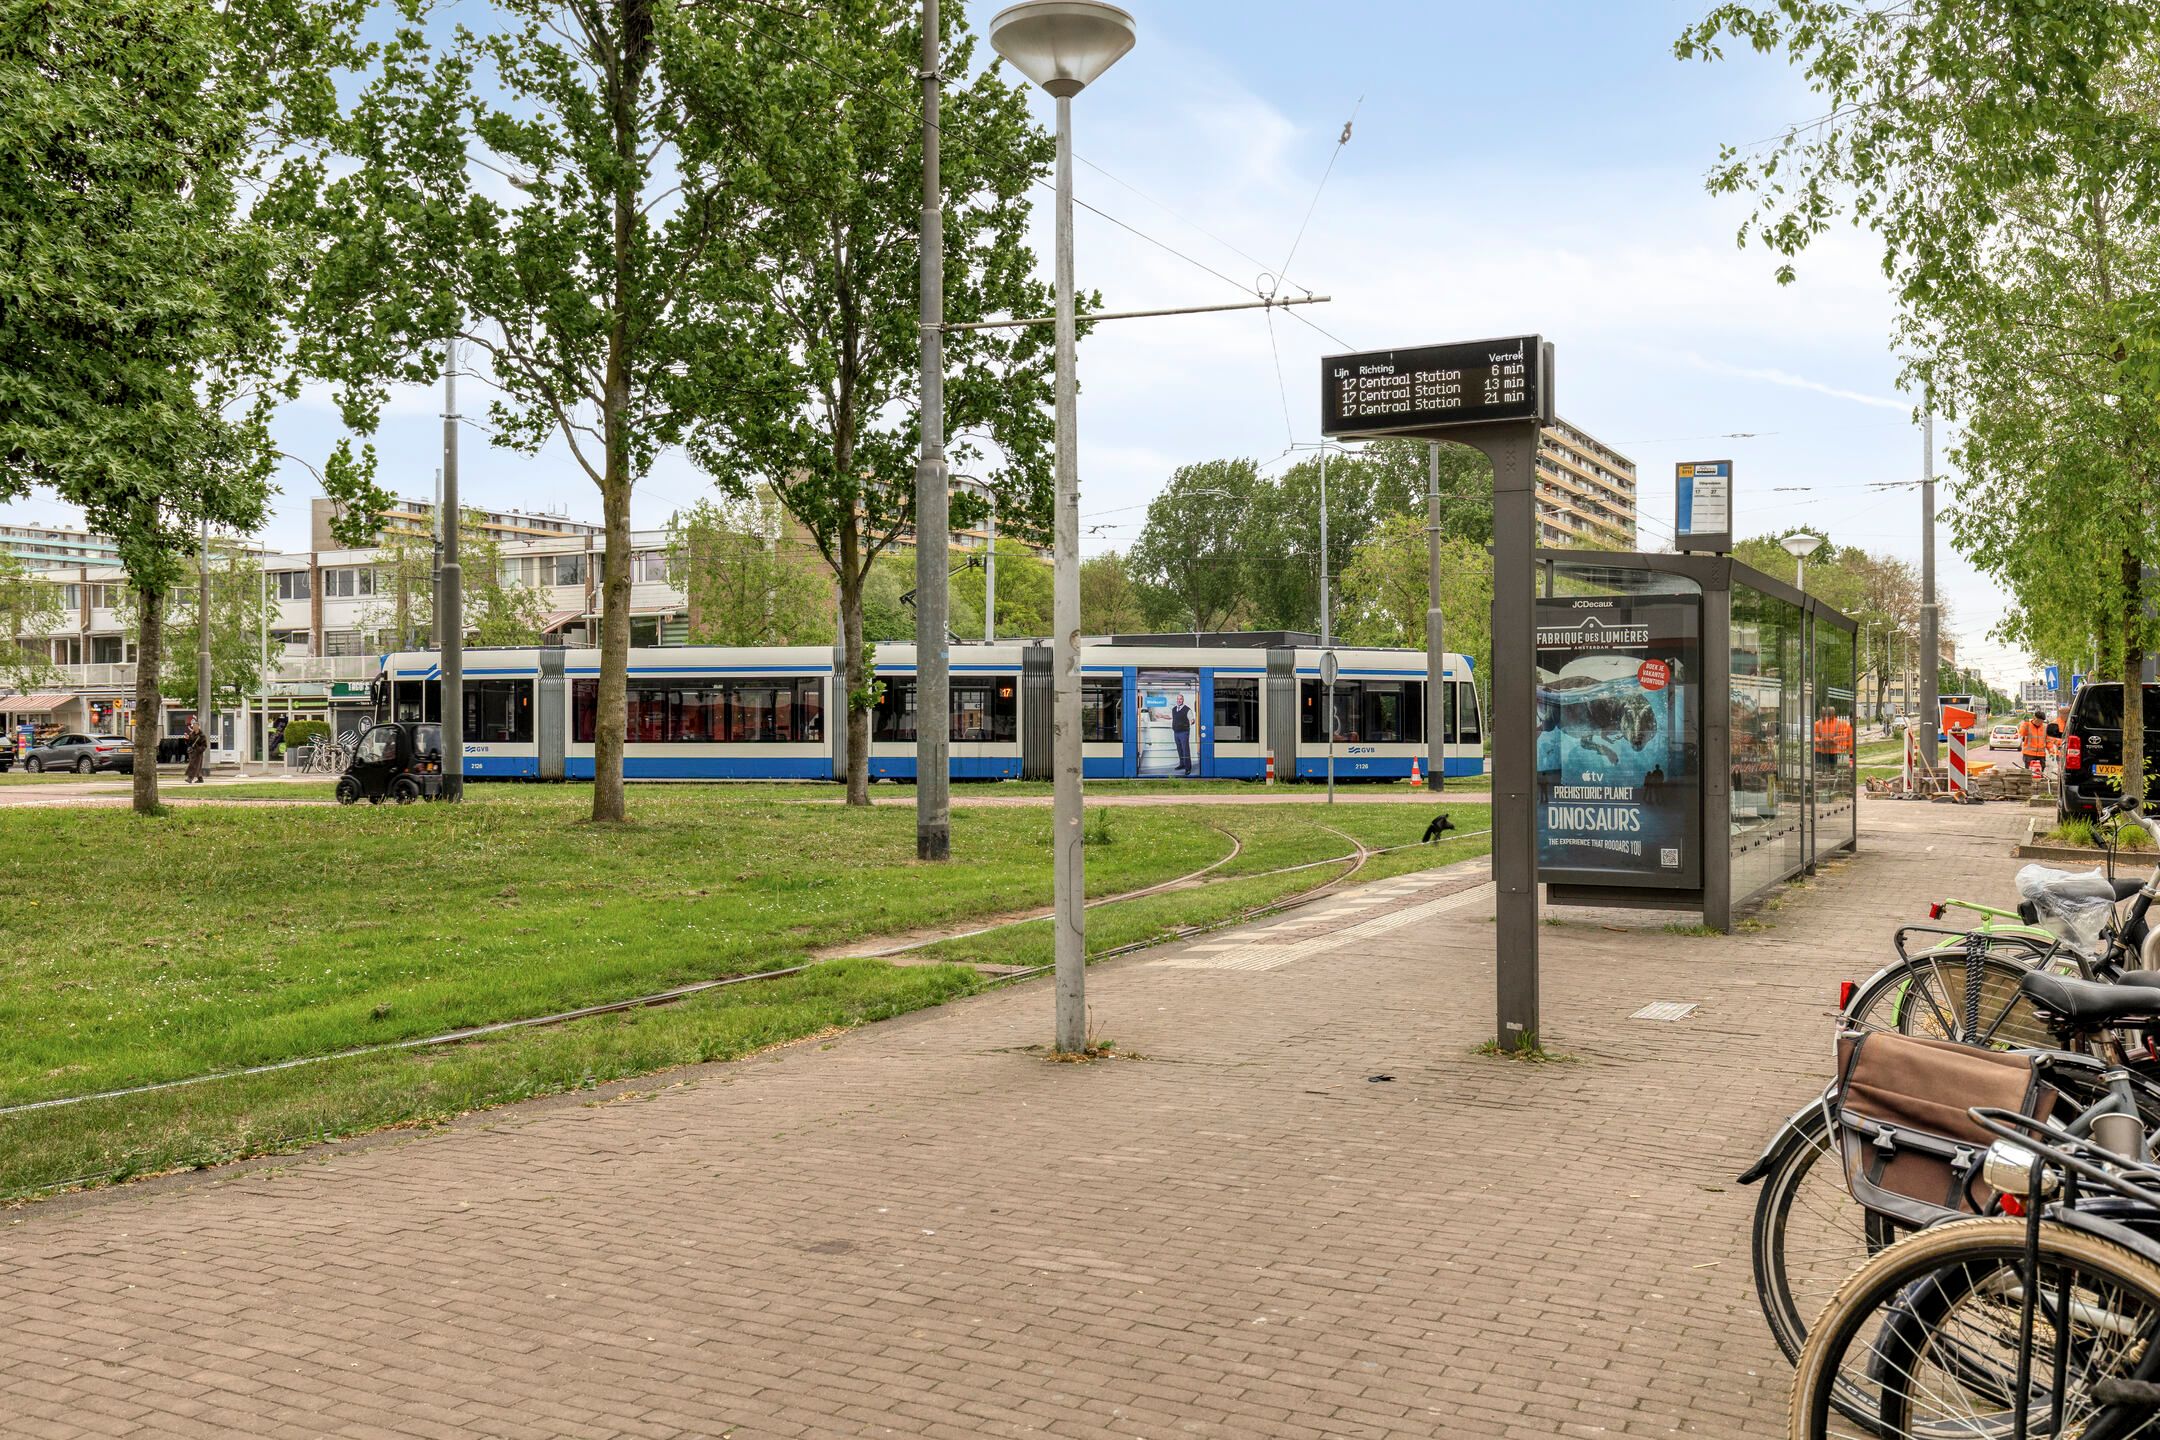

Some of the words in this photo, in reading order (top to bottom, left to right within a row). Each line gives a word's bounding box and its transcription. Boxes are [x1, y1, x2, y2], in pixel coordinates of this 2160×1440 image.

[1334, 368, 1349, 379] Lijn
[1359, 364, 1395, 375] Richting
[1489, 352, 1524, 363] Vertrek
[1342, 379, 1357, 391] 17
[1359, 374, 1410, 389] Centraal
[1415, 370, 1461, 384] Station
[1491, 366, 1499, 376] 6
[1504, 363, 1524, 375] min
[1342, 392, 1357, 404] 17
[1359, 387, 1410, 402] Centraal
[1415, 383, 1461, 397] Station
[1484, 379, 1499, 391] 13
[1504, 377, 1524, 389] min
[1342, 405, 1357, 417] 17
[1359, 400, 1410, 415] Centraal
[1415, 396, 1461, 410] Station
[1484, 392, 1499, 404] 21
[1504, 391, 1524, 402] min
[1572, 600, 1613, 609] JCDecaux
[1536, 632, 1583, 645] FABRIQUE
[1585, 632, 1599, 642] DES
[1600, 628, 1649, 643] LUMIÈRES
[1002, 688, 1011, 697] 17
[1592, 772, 1604, 782] tv
[1554, 786, 1602, 800] PREHISTORIC
[1604, 786, 1633, 800] PLANET
[1548, 806, 1640, 831] DINOSAURS
[1548, 838, 1559, 846] THE
[1559, 838, 1591, 847] EXPERIENCE
[1591, 839, 1604, 849] THAT
[1630, 840, 1641, 857] YOU
